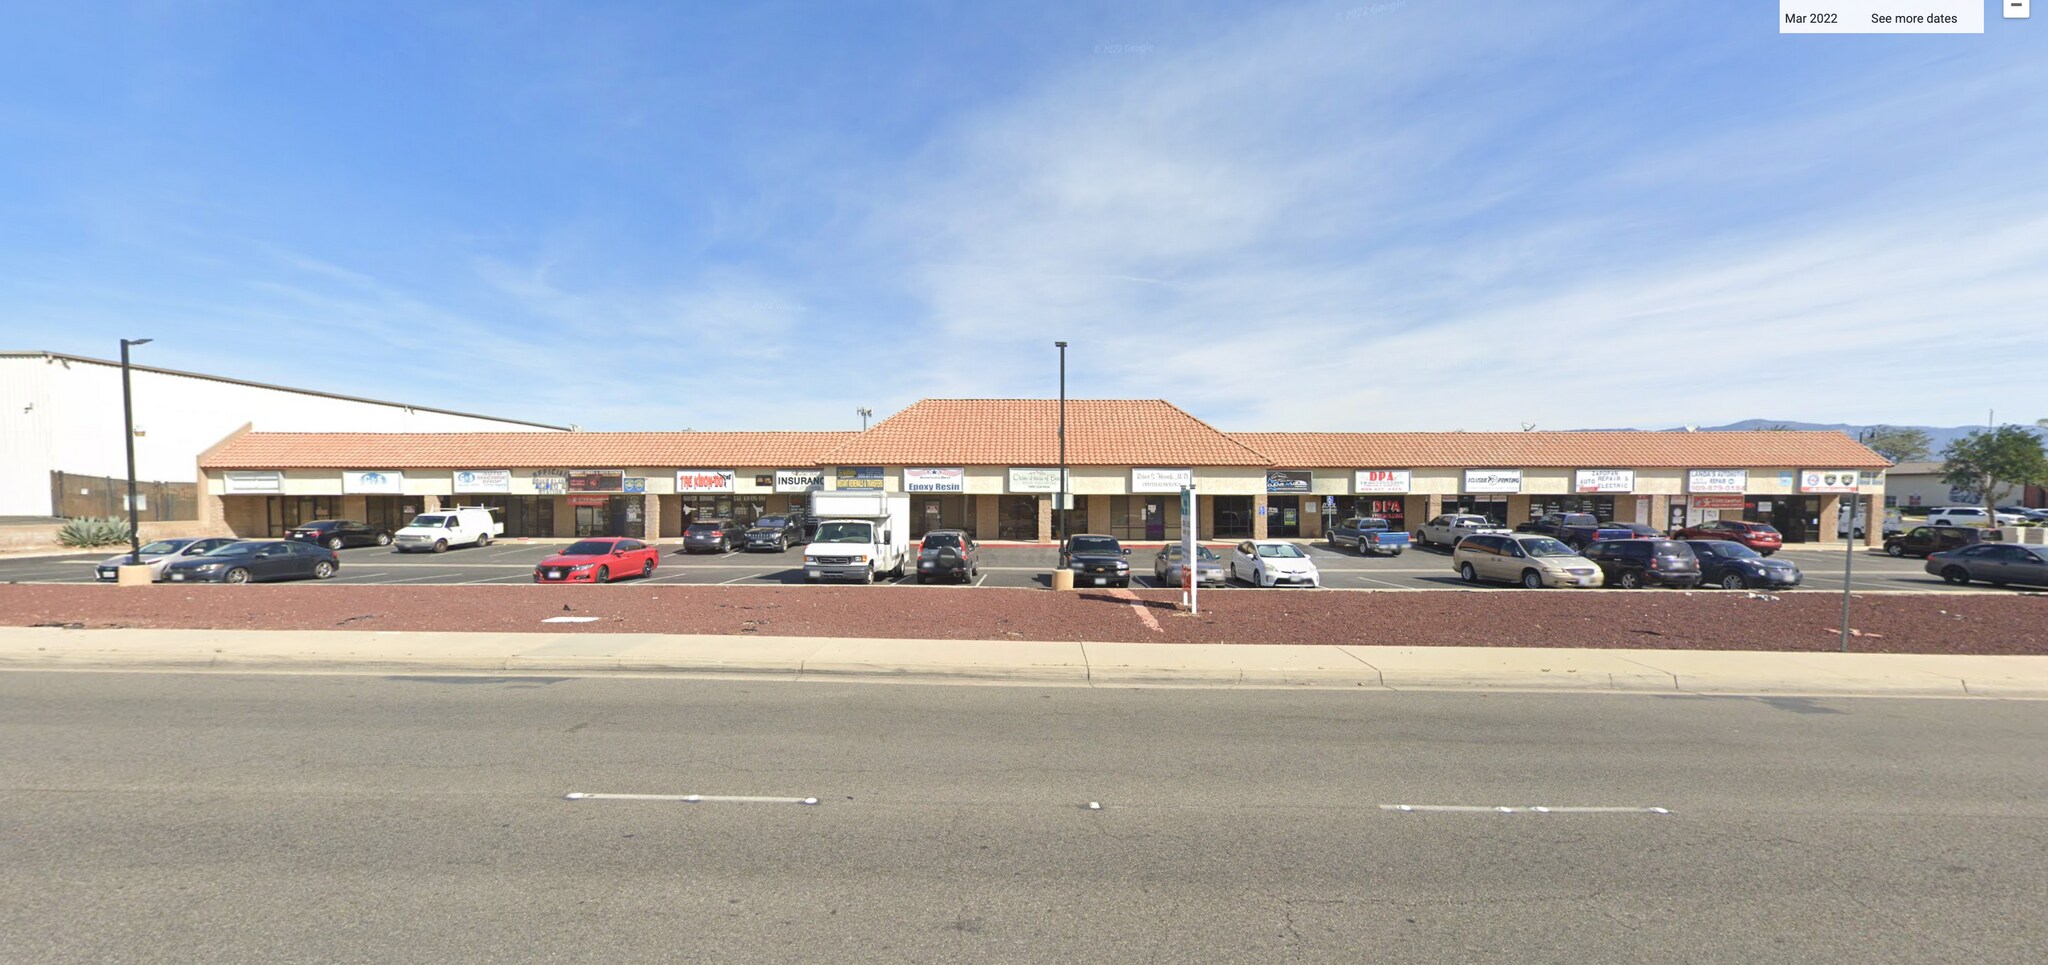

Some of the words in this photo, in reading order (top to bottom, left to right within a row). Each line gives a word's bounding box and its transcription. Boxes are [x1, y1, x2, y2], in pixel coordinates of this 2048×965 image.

[1369, 471, 1394, 481] DPA
[908, 483, 934, 491] Epoxy
[1372, 500, 1402, 512] DPA
